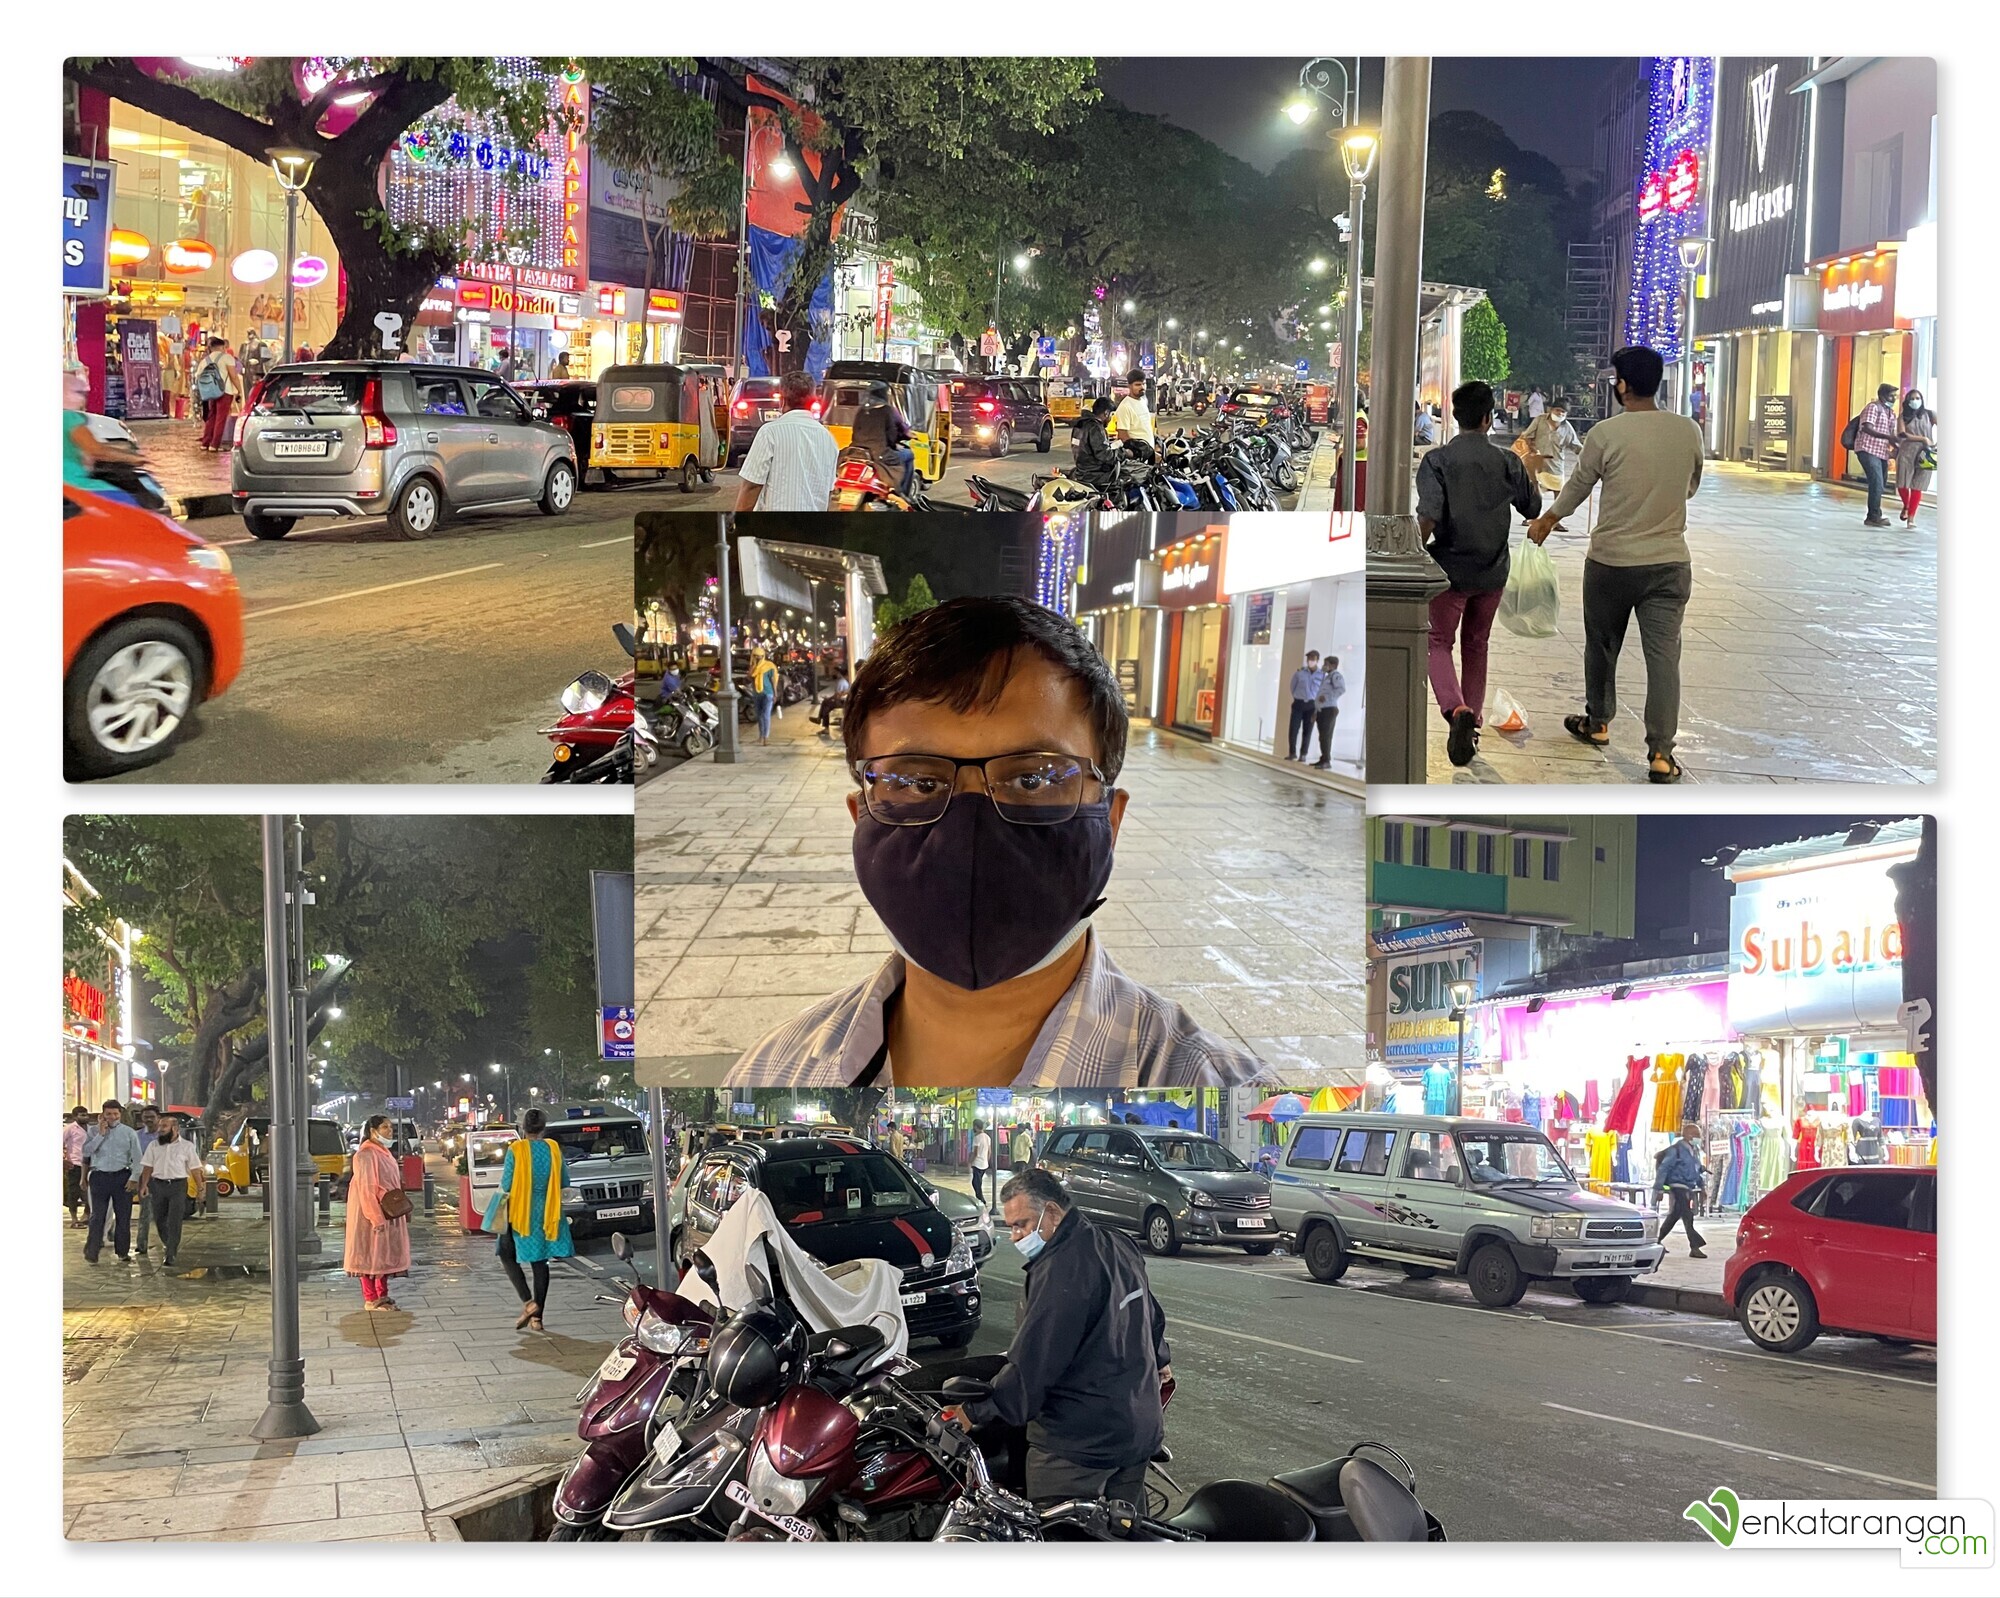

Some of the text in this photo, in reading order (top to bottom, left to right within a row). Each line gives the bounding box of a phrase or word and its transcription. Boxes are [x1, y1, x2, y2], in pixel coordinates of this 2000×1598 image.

[1389, 958, 1469, 1015] SUN
[1415, 1015, 1473, 1039] COVERIG
[782, 1444, 804, 1460] HONDA
[734, 1486, 813, 1540] TN 8563
